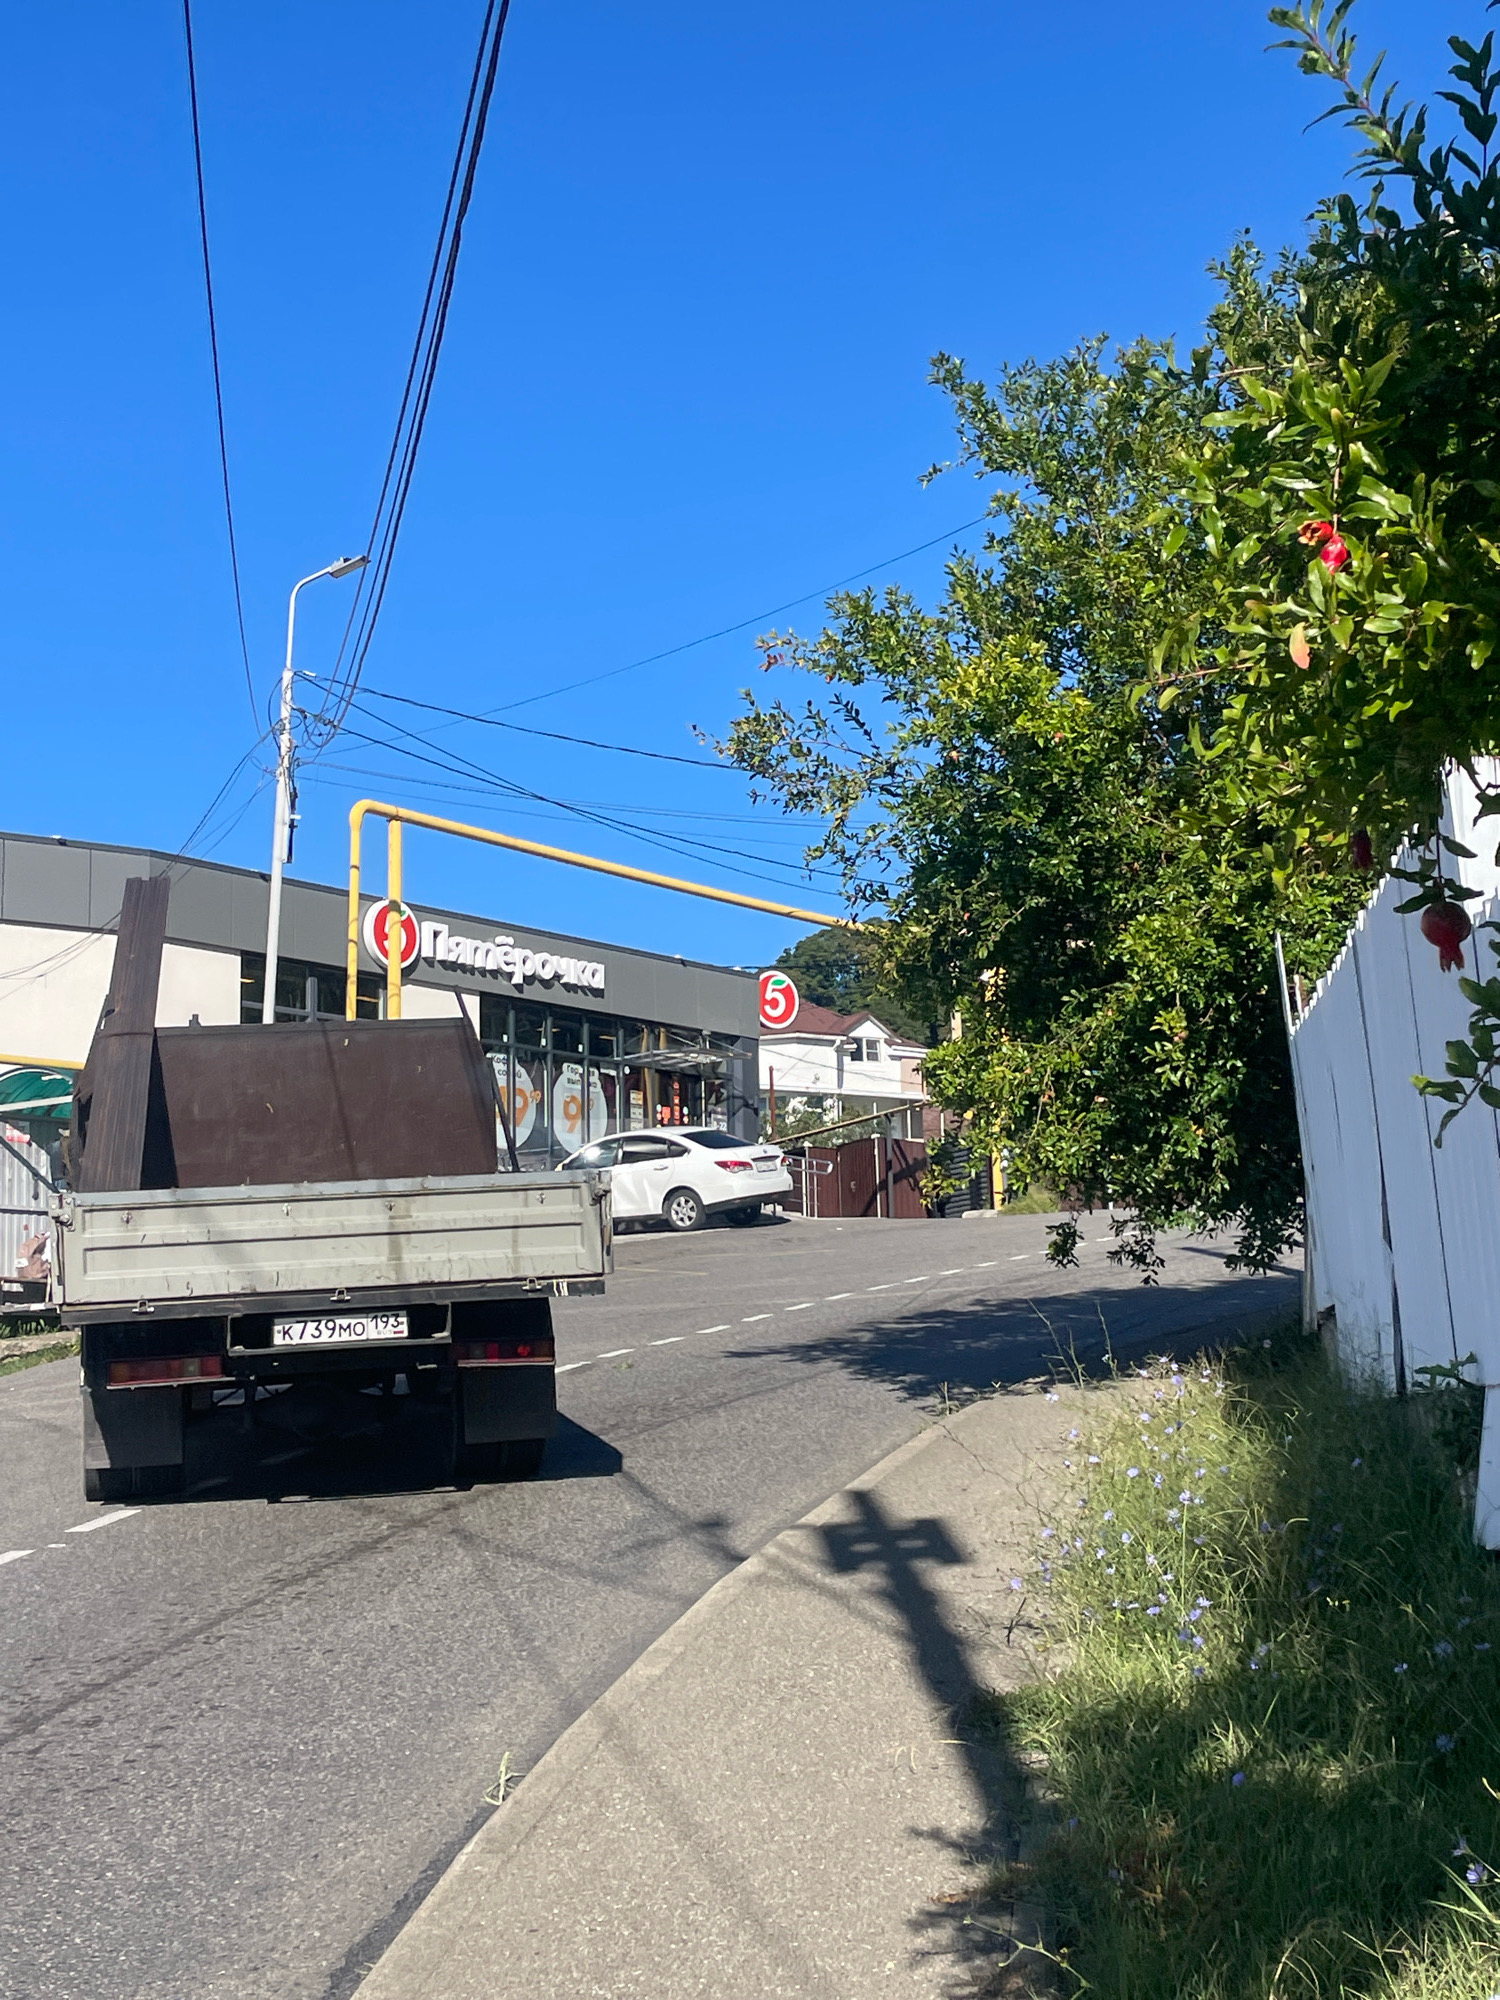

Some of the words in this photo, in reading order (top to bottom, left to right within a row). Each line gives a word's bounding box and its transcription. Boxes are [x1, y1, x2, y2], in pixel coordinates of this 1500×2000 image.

[420, 920, 605, 990] Пятёрочка
[763, 975, 788, 1018] 5
[370, 1313, 400, 1330] 193
